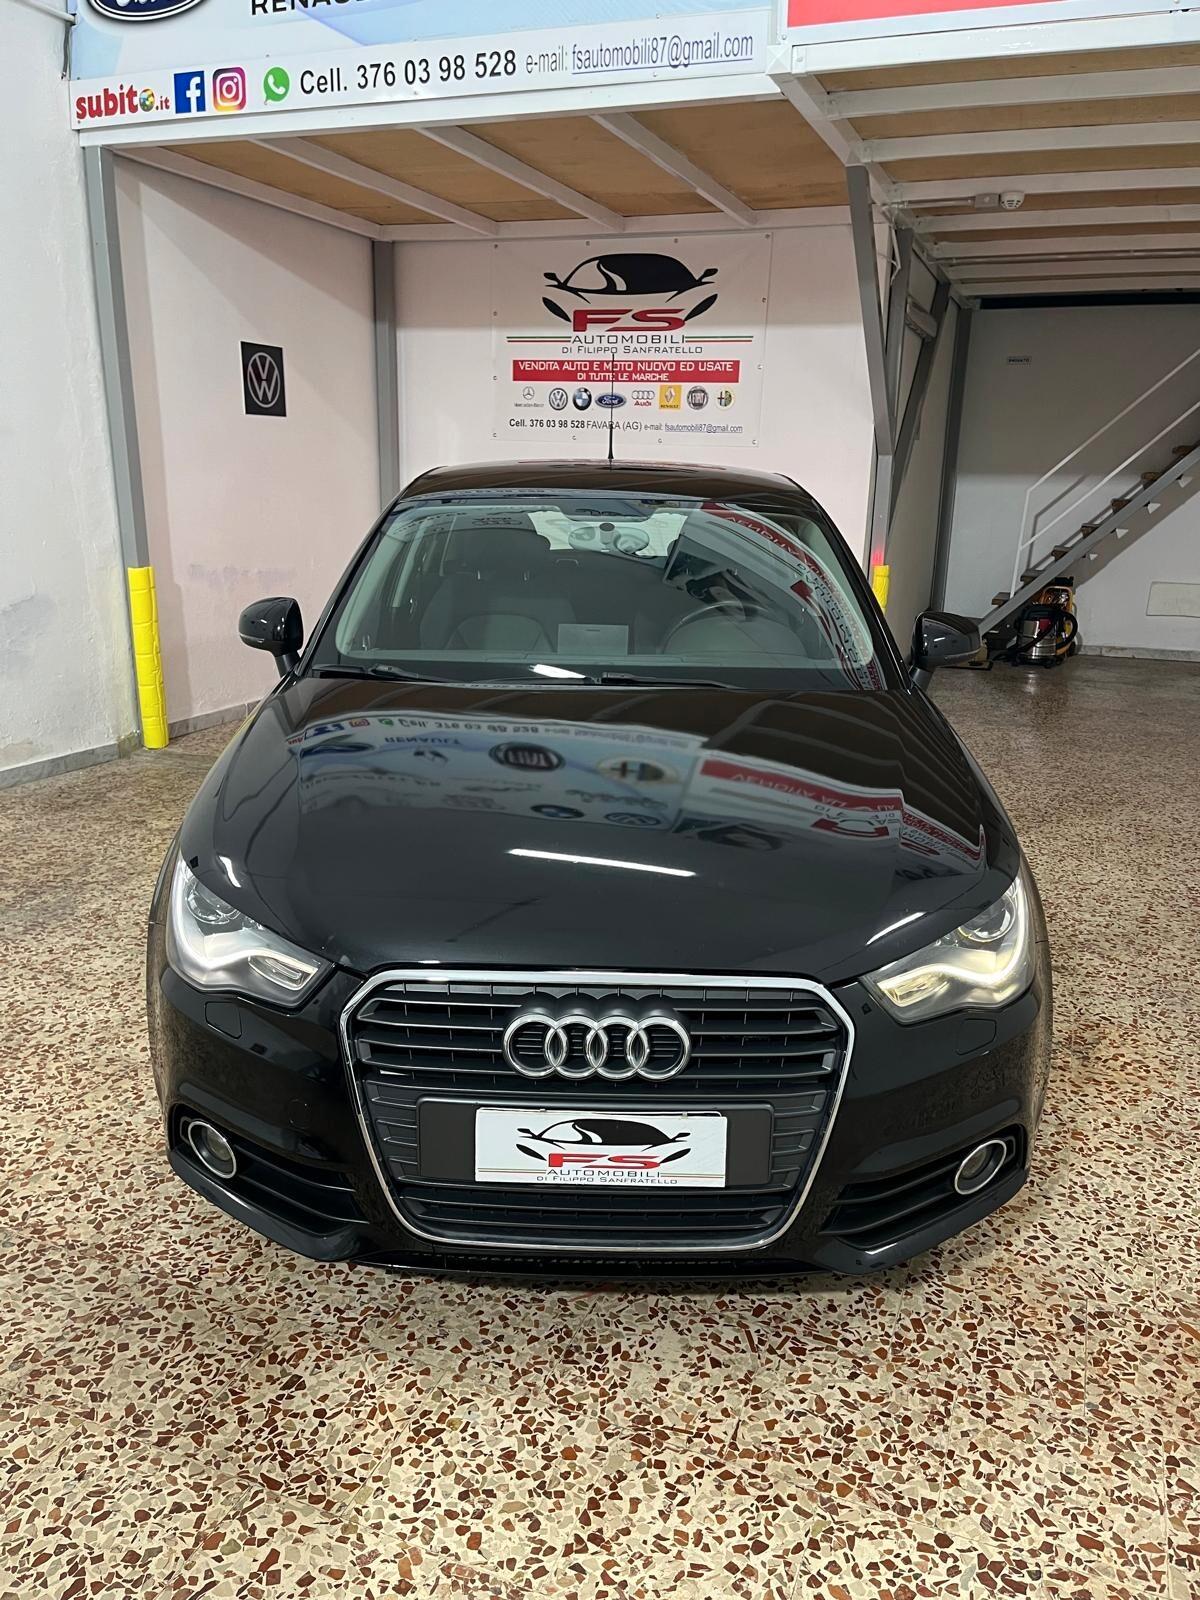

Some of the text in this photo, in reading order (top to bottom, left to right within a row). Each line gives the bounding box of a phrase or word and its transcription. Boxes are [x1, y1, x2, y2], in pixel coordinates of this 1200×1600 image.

[300, 33, 753, 94] Cell. 376 03 98 528 e-mail: fsautomobili87@gmail.com
[573, 309, 686, 332] FS
[572, 335, 685, 344] AUTOMOBILI
[623, 346, 703, 354] SANFRATELLO
[518, 361, 734, 372] VENDITA AUTO E MOTO NUOVO ED USATE
[632, 373, 670, 381] MARCHE
[509, 418, 528, 428] Cell.
[529, 419, 545, 428] 376
[546, 419, 556, 428] 03
[558, 420, 568, 429] 98
[570, 420, 586, 429] 528
[586, 420, 621, 430] FAVARA
[622, 421, 643, 431] (AG)
[548, 1153, 661, 1170] FS
[547, 1169, 660, 1178] AUTOMOBILI
